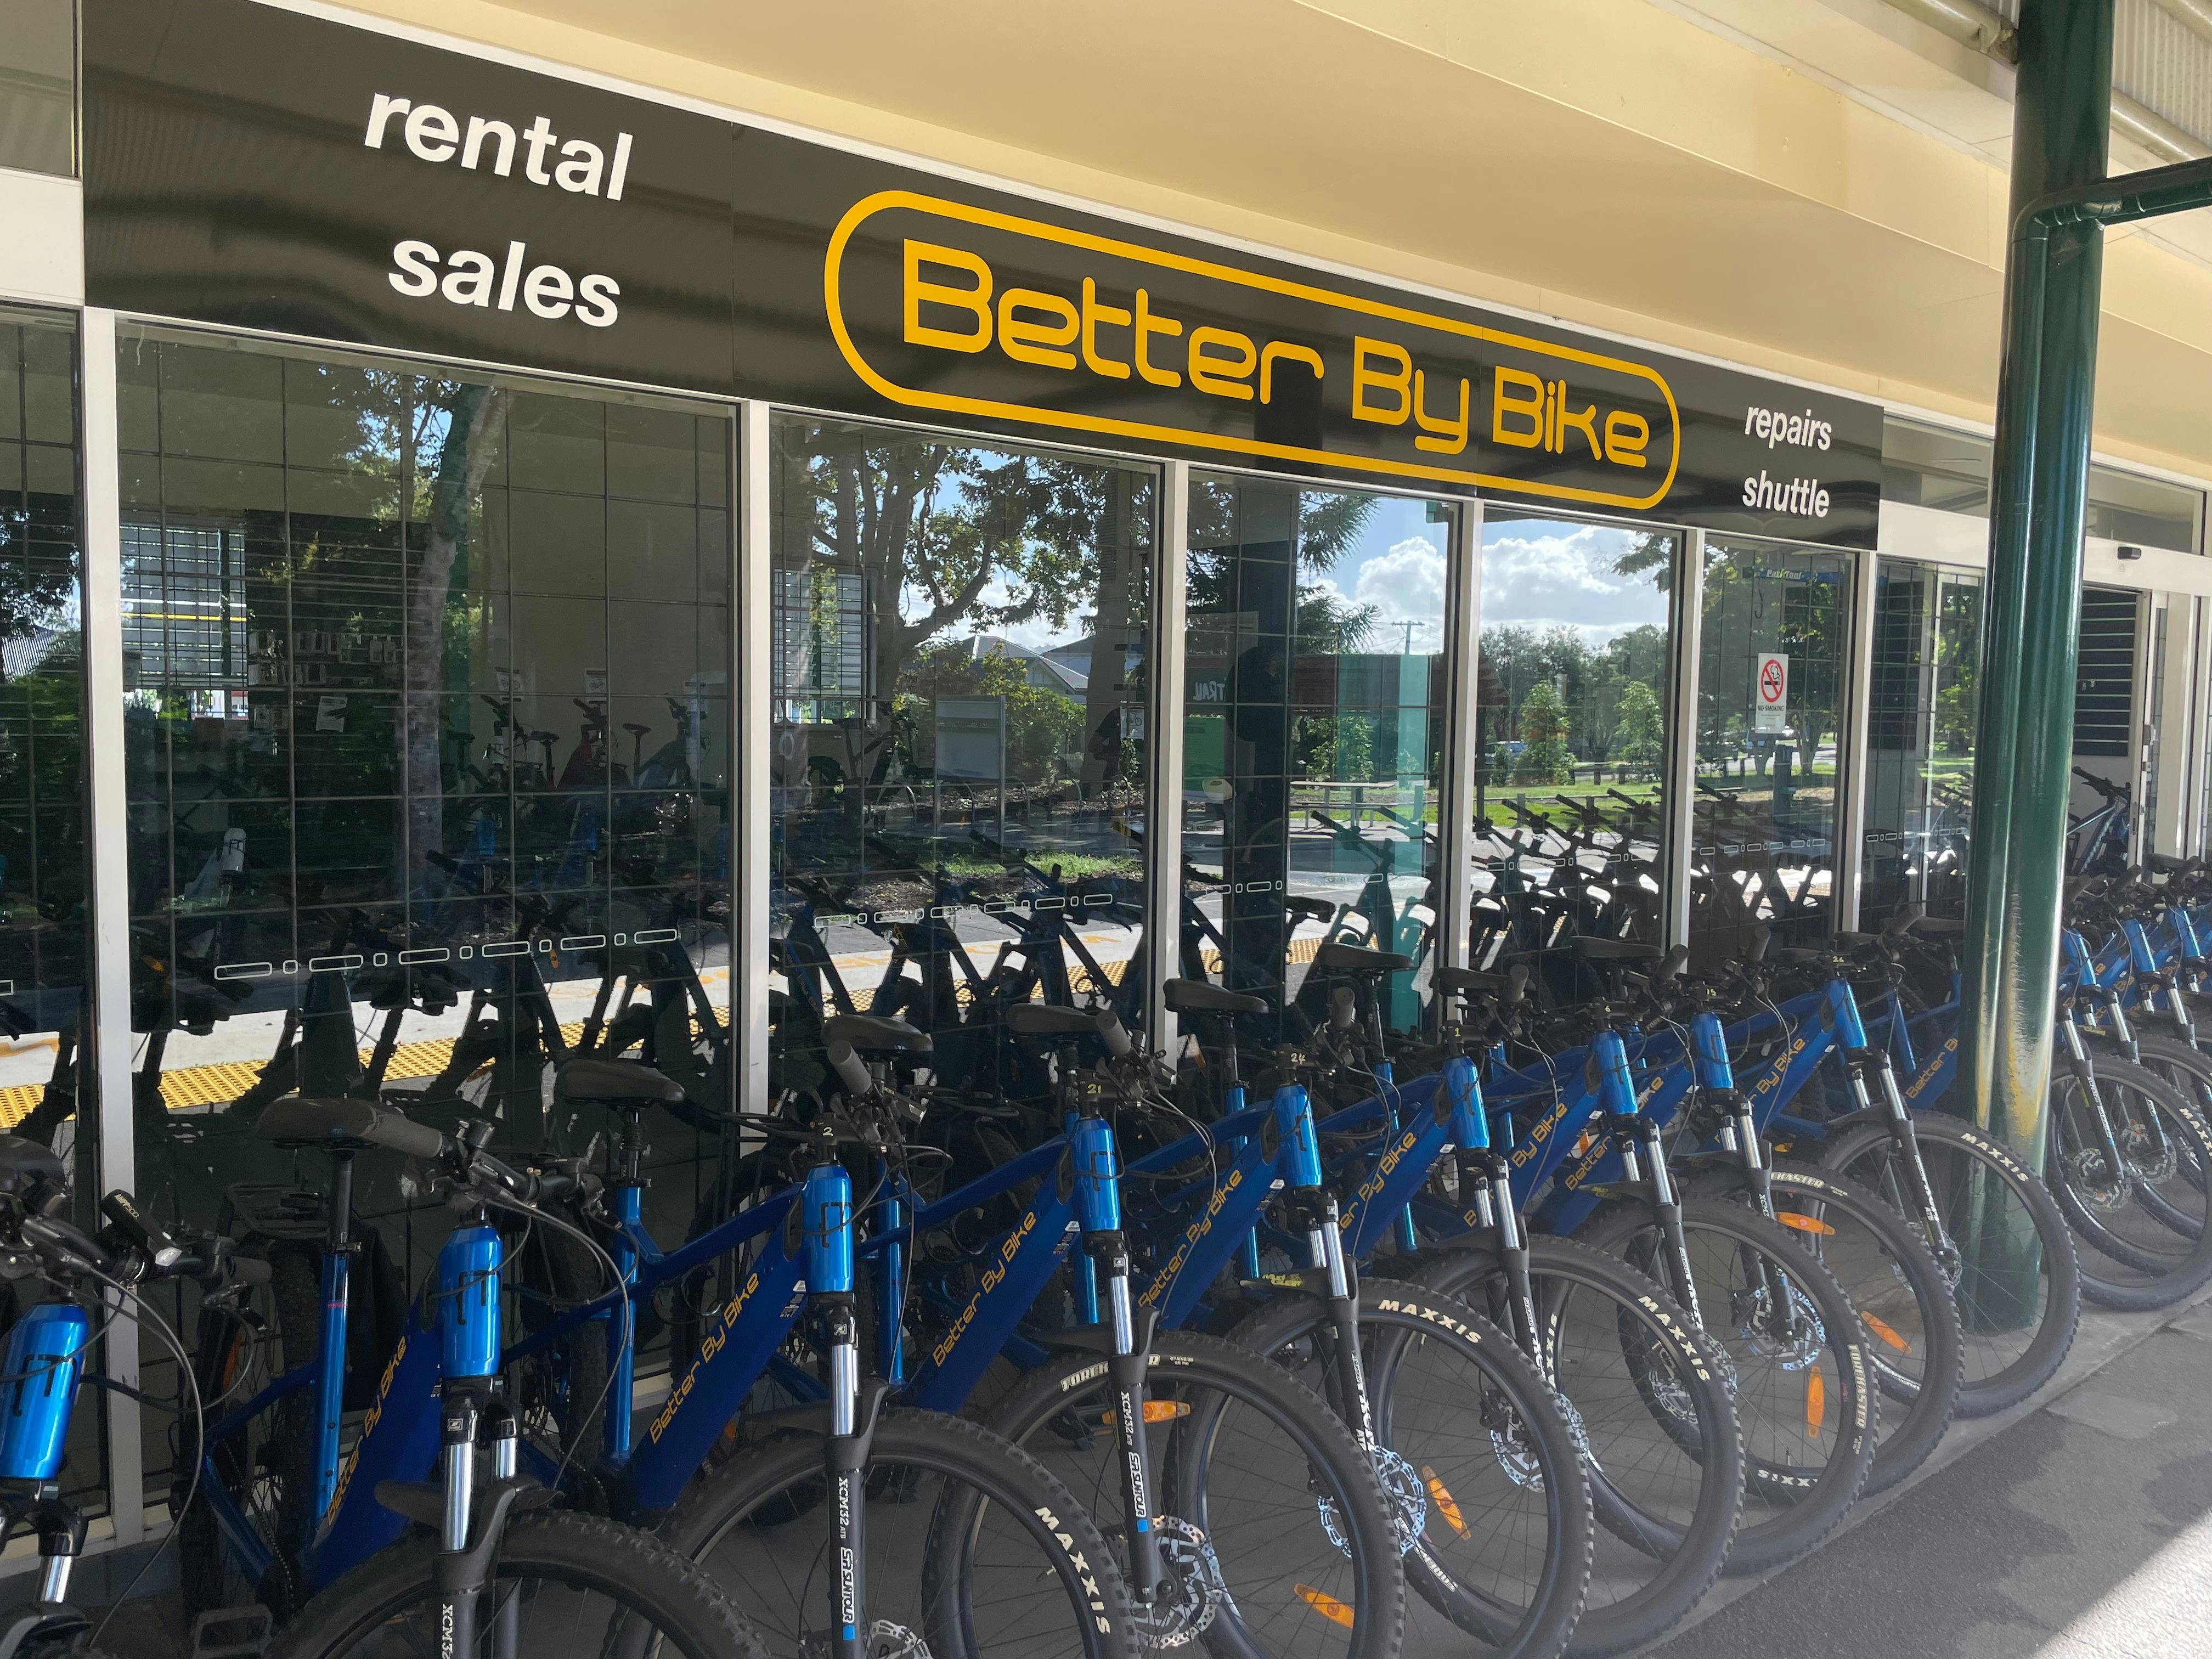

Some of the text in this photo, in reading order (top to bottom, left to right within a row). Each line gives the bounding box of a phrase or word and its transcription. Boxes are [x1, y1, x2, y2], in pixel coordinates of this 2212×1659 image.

[365, 93, 633, 201] rental
[388, 240, 620, 327] sales
[904, 239, 1649, 468] Better By Bike
[1745, 407, 1832, 450] repairs
[1742, 470, 1830, 518] shuttle
[1706, 988, 1717, 997] 15
[1290, 1053, 1306, 1065] 24
[1756, 1070, 1780, 1094] By
[1905, 1052, 1946, 1099] Better
[1380, 1132, 1417, 1176] Bike
[1511, 1103, 1568, 1168] By Bike
[1960, 1132, 2029, 1182] MAXXIS
[1565, 1136, 1612, 1191] Better
[933, 1211, 1036, 1368] Better By Bike
[1379, 1298, 1482, 1344] MAXXIS
[1638, 1295, 1711, 1381] MAXXIS
[650, 1271, 759, 1444] Better By Bike
[1546, 1313, 1558, 1389] AXXIS
[364, 1394, 382, 1438] By
[381, 1335, 407, 1400] Bike
[1121, 1390, 1133, 1435] XCM32
[839, 1476, 849, 1526] XCM32
[1035, 1506, 1111, 1634] MAXXIS
[442, 1603, 453, 1659] XCM32
